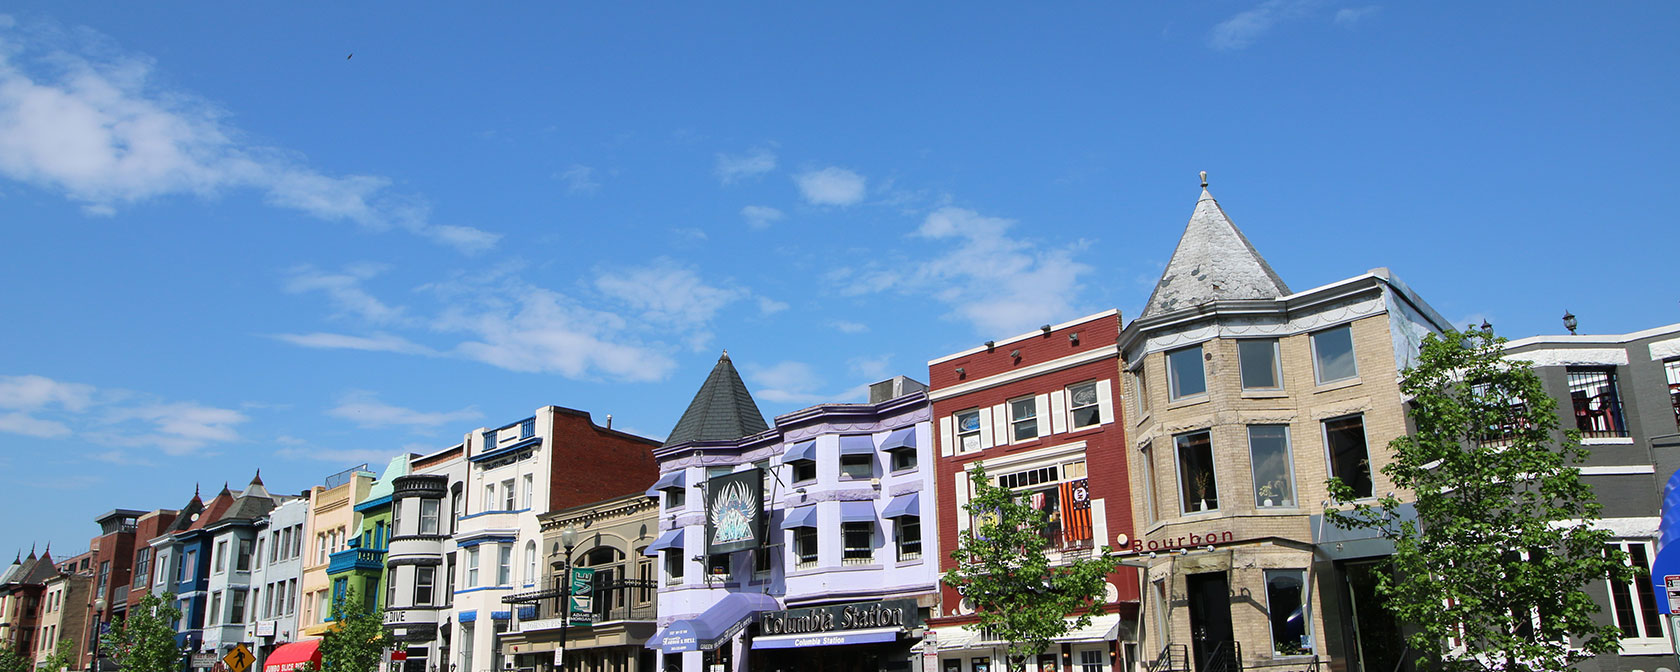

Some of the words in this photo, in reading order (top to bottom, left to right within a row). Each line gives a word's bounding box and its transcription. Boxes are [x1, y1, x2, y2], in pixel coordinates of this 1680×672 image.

[1131, 530, 1233, 552] Bourbon
[572, 571, 593, 613] LIVE
[389, 611, 405, 622] DIVE
[763, 608, 835, 634] Columbia
[841, 603, 903, 628] Station
[794, 637, 821, 647] Columbia
[822, 636, 845, 645] Station
[281, 663, 294, 672] SLICE
